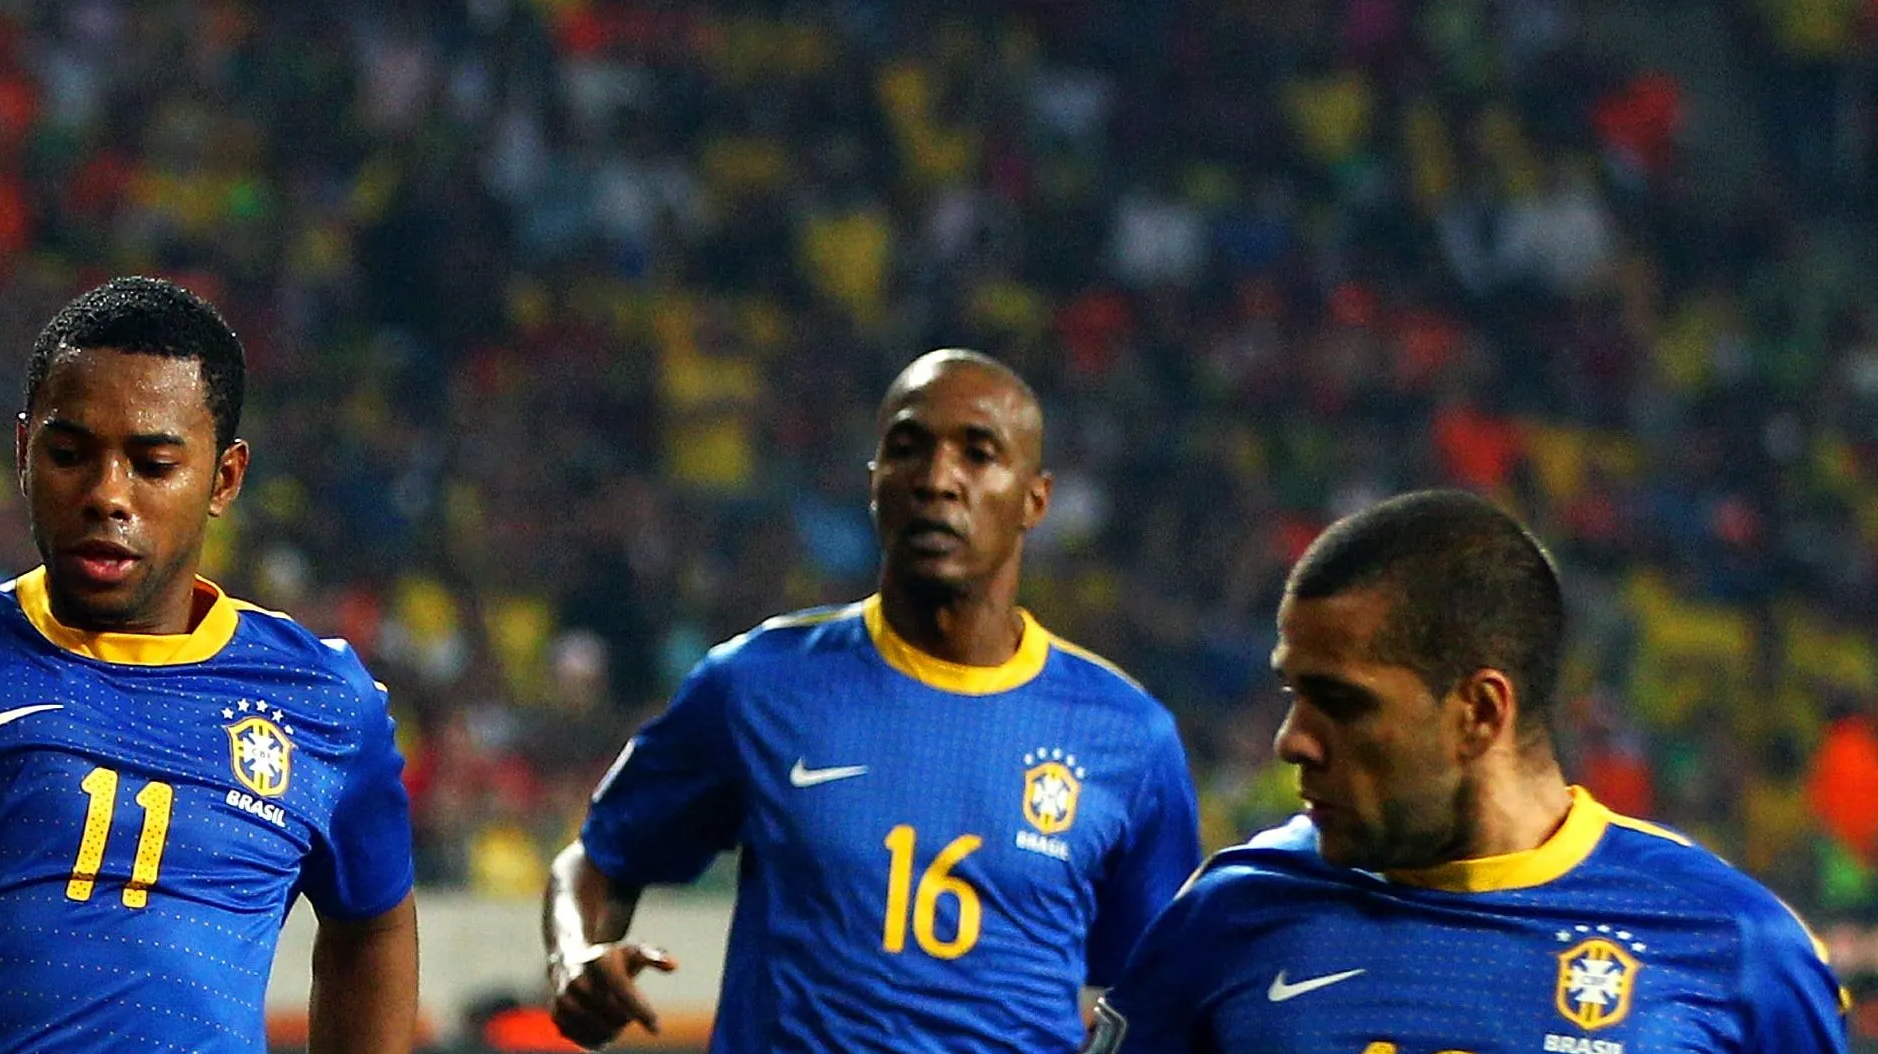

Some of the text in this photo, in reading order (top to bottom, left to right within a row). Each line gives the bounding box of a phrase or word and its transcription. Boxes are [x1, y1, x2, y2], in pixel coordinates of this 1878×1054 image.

[66, 767, 173, 908] 11
[225, 789, 287, 828] BRASIL
[882, 823, 983, 960] 16
